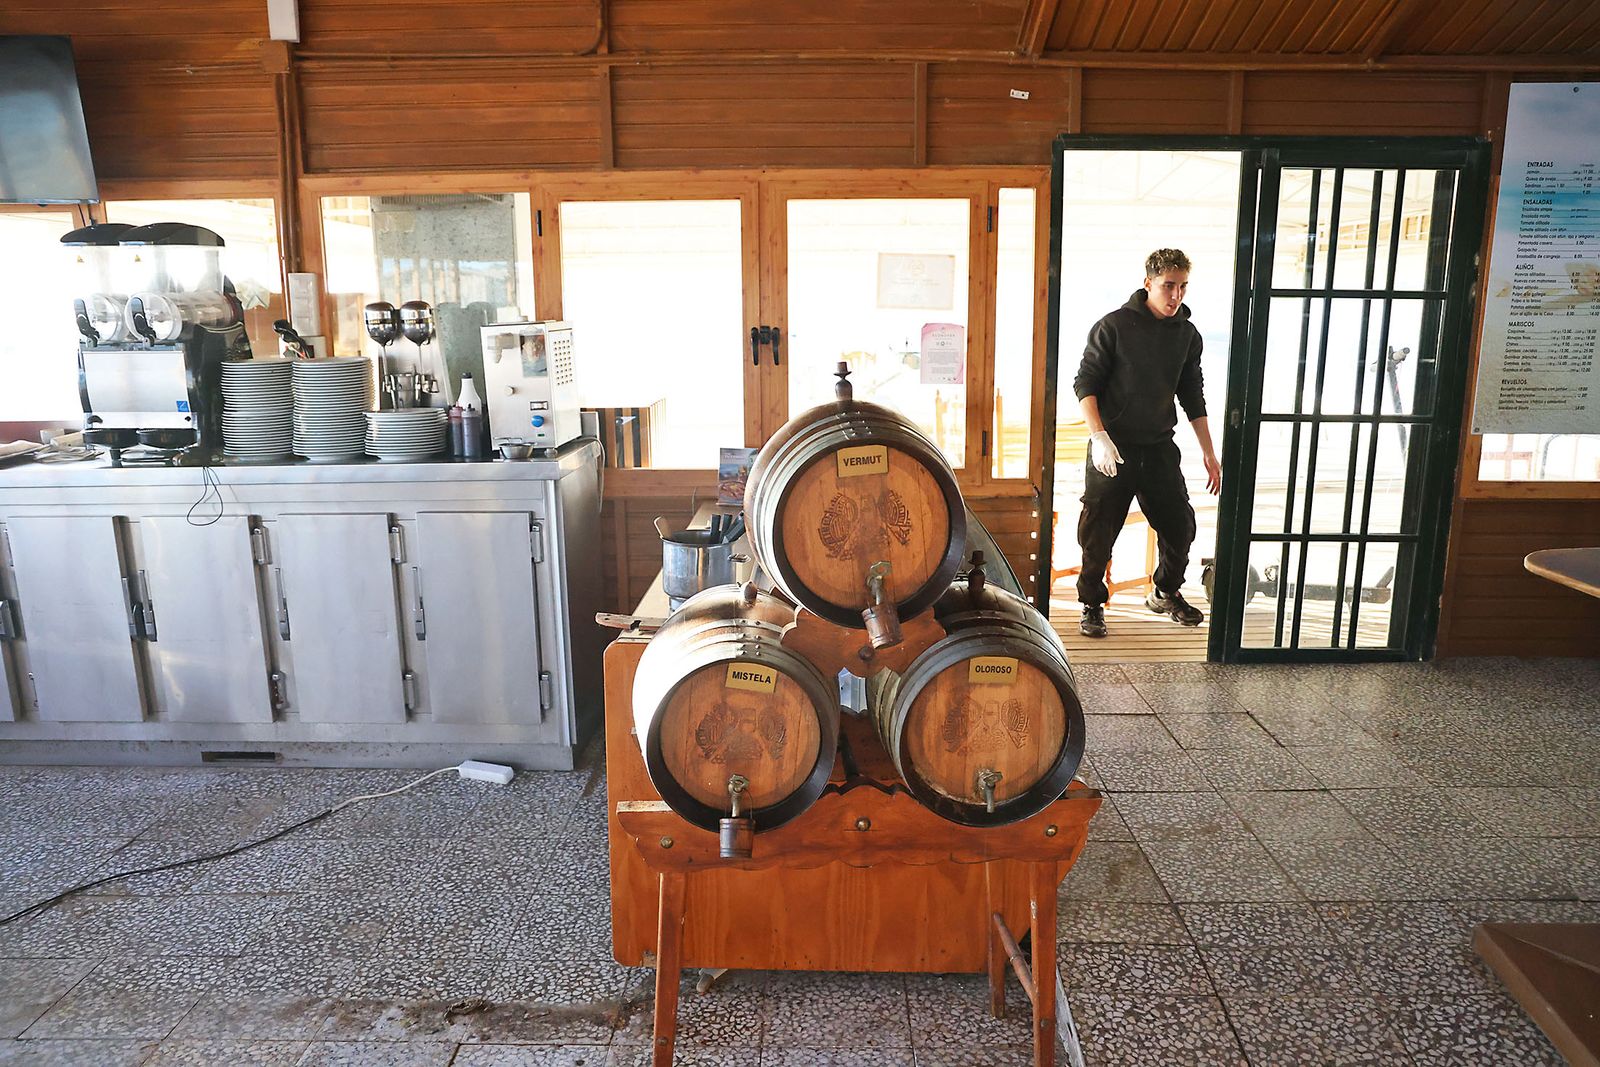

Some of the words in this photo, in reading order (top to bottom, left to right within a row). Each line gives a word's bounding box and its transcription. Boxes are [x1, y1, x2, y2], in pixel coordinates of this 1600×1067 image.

[843, 455, 882, 466] VERMUT
[975, 665, 1012, 674] OLOROSO
[732, 671, 772, 684] MISTELA
